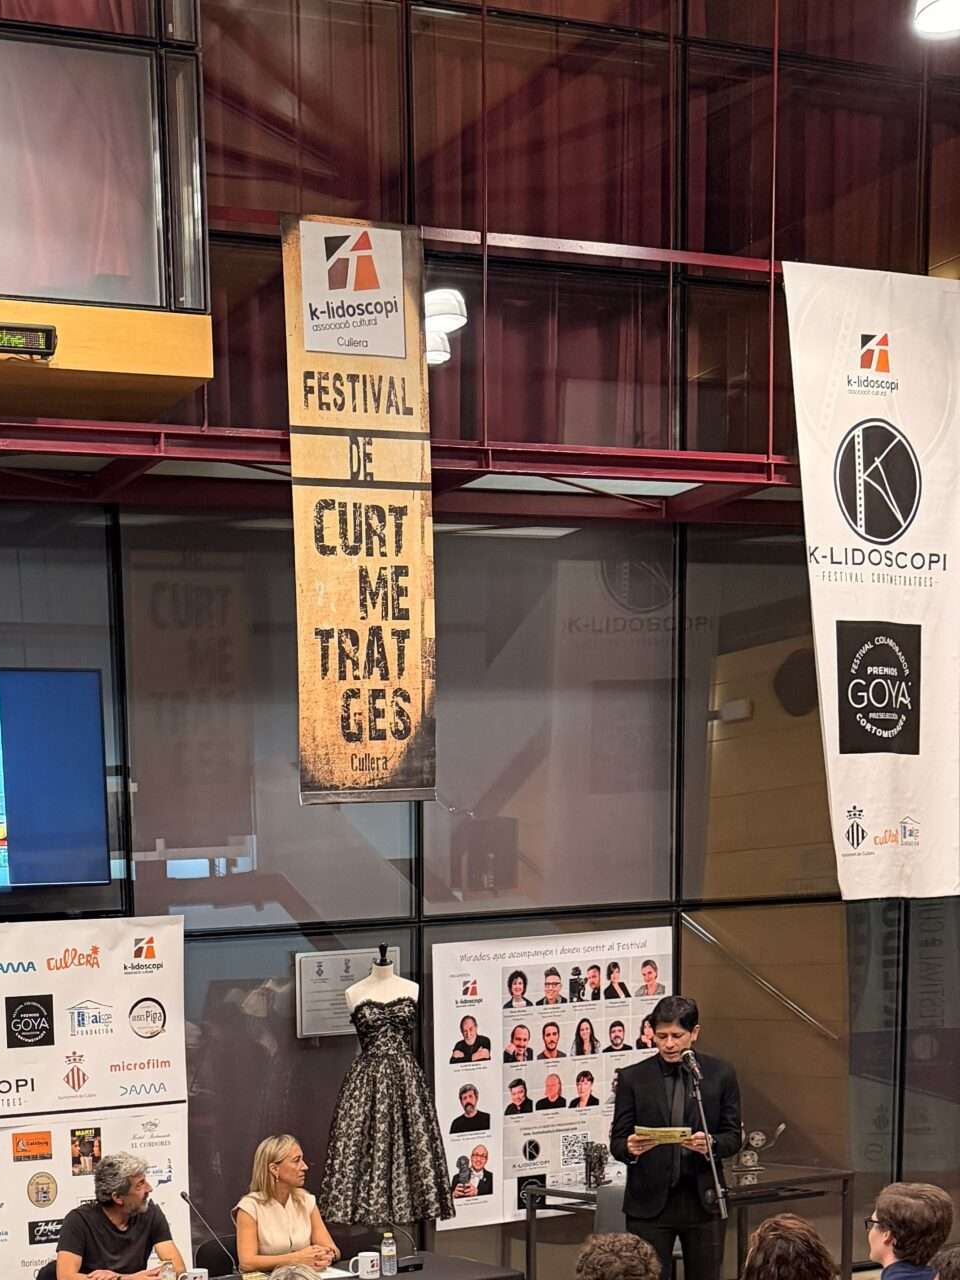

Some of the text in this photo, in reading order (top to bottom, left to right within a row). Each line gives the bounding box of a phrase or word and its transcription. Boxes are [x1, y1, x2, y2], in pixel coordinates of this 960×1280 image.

[308, 296, 399, 321] k-lidoscopi
[337, 336, 369, 348] Cullera
[303, 370, 414, 416] FESTIVAL
[847, 375, 899, 393] k-lidoscopi
[349, 436, 375, 481] DE
[313, 498, 408, 557] CURT
[809, 546, 948, 571] K-LIDOSCOPI
[359, 565, 410, 621] ME
[314, 626, 410, 681] TRAT
[847, 678, 912, 710] GOYA
[341, 688, 412, 744] GES
[351, 753, 389, 772] Cullera
[617, 940, 648, 951] Festival
[124, 962, 164, 971] k-lidoscopi
[11, 1018, 49, 1032] GOYA
[110, 1058, 171, 1073] microfilm
